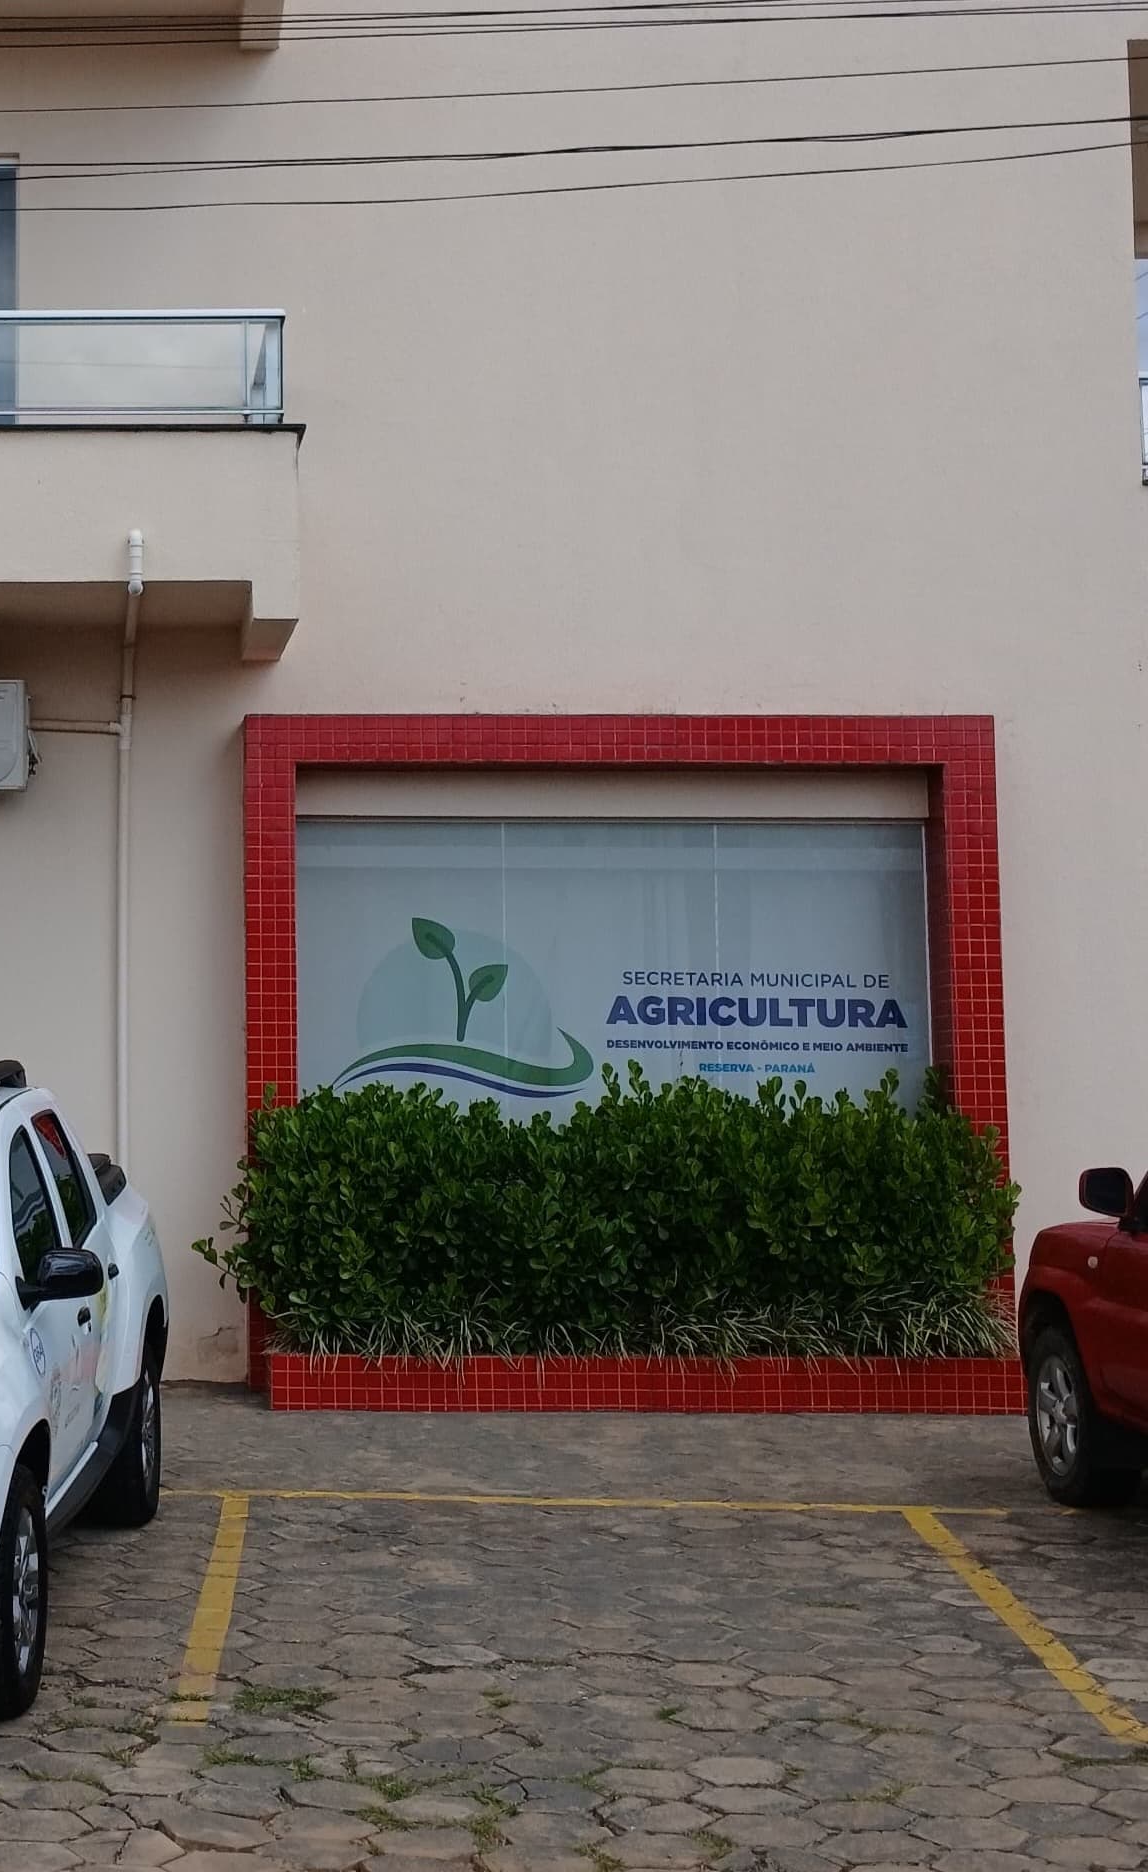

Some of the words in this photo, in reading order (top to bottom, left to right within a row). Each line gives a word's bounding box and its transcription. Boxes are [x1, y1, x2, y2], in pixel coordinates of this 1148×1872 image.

[622, 971, 744, 987] SECRETARIA
[750, 972, 857, 988] MUNICIPAL
[863, 974, 890, 989] DE
[606, 995, 908, 1028] AGRICULTURA
[606, 1039, 724, 1050] DESENVOLVIMENTO
[726, 1040, 800, 1051] ECONÔMICO
[802, 1042, 810, 1051] E
[813, 1042, 843, 1051] MEIO
[846, 1043, 909, 1053] AMBIENTE
[699, 1063, 755, 1073] RESERVA
[764, 1062, 816, 1073] PARANÁ
